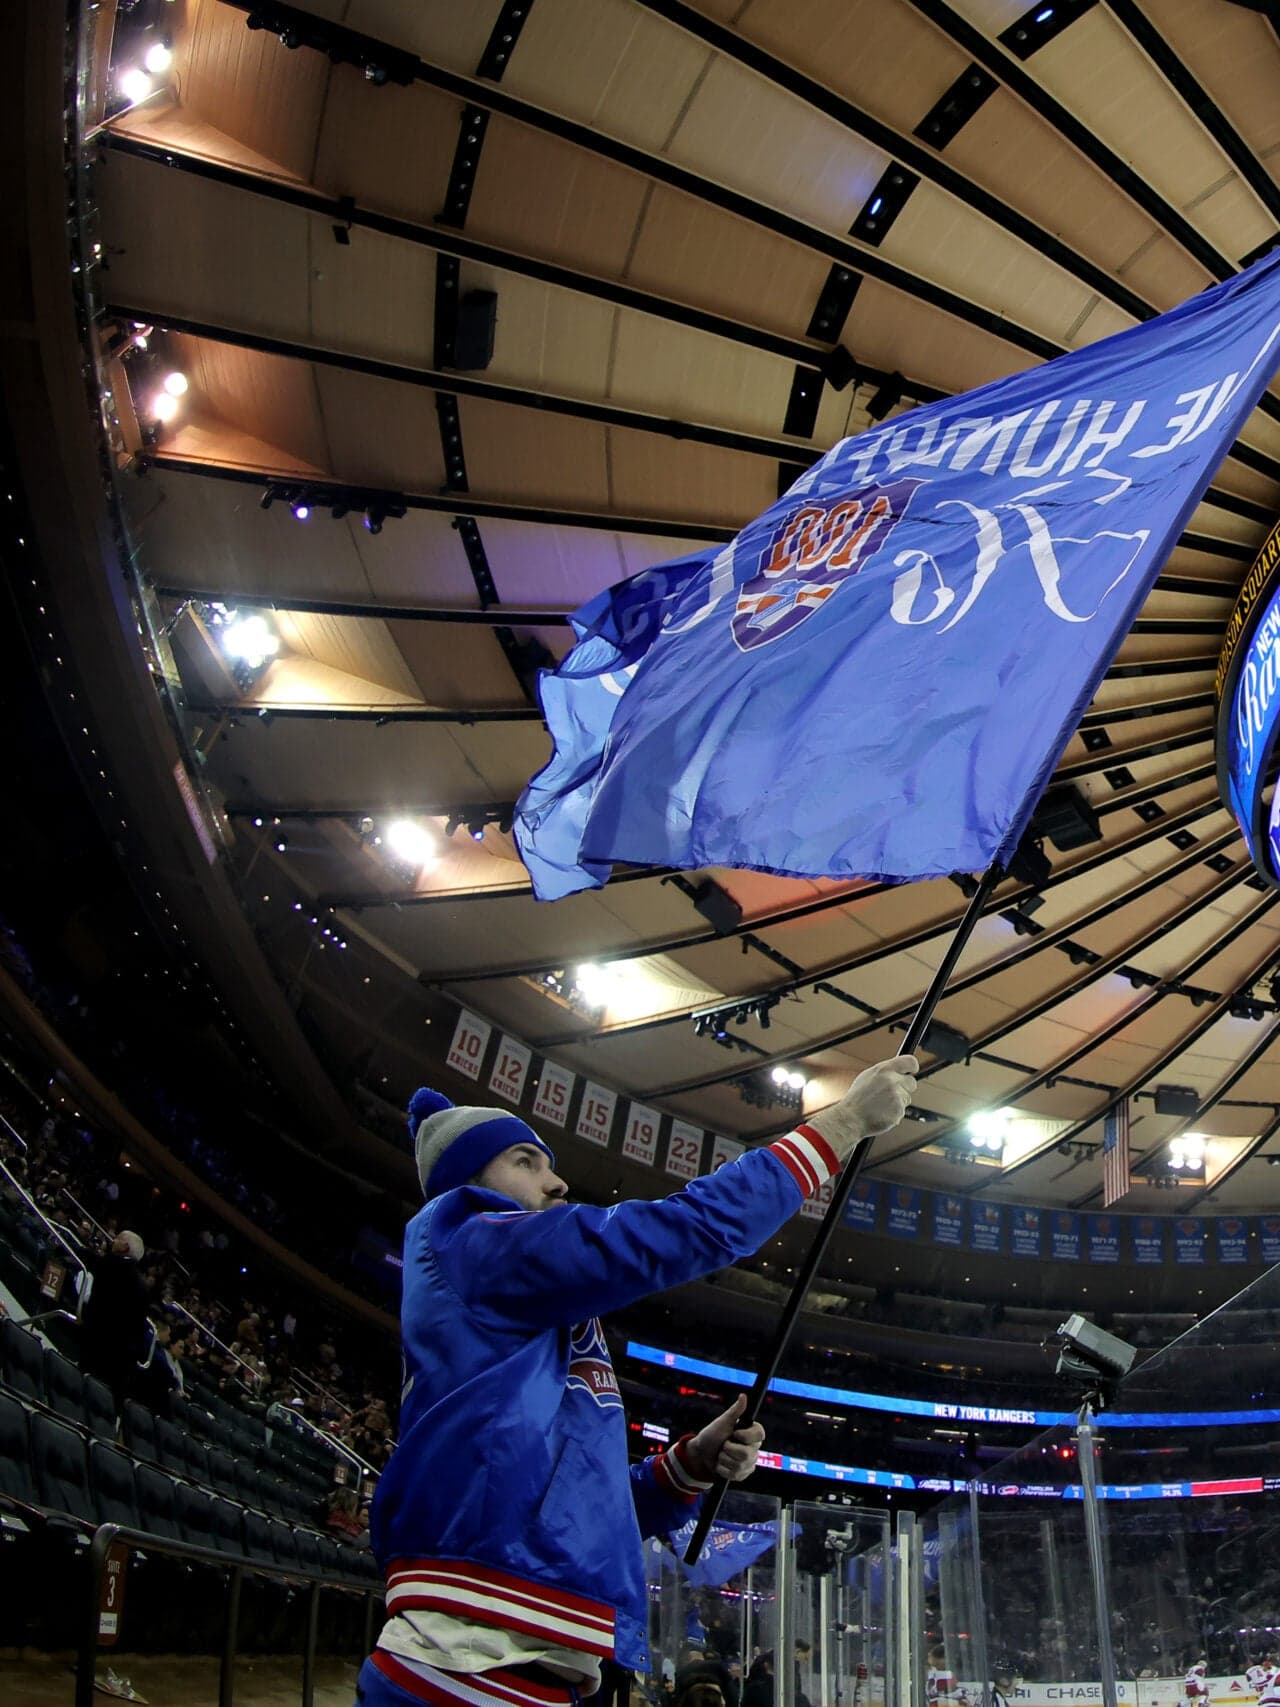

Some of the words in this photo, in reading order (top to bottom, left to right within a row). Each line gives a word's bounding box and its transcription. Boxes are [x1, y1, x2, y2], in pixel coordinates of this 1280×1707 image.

[457, 1029, 482, 1058] 10
[499, 1055, 522, 1083] 12
[542, 1079, 567, 1107] 15
[586, 1099, 609, 1127] 15
[631, 1120, 653, 1145] 19
[671, 1136, 698, 1164] 22
[934, 1403, 958, 1418] NEW
[959, 1406, 987, 1420] YORK
[988, 1409, 1036, 1425] RANGERS
[107, 1575, 116, 1607] 3
